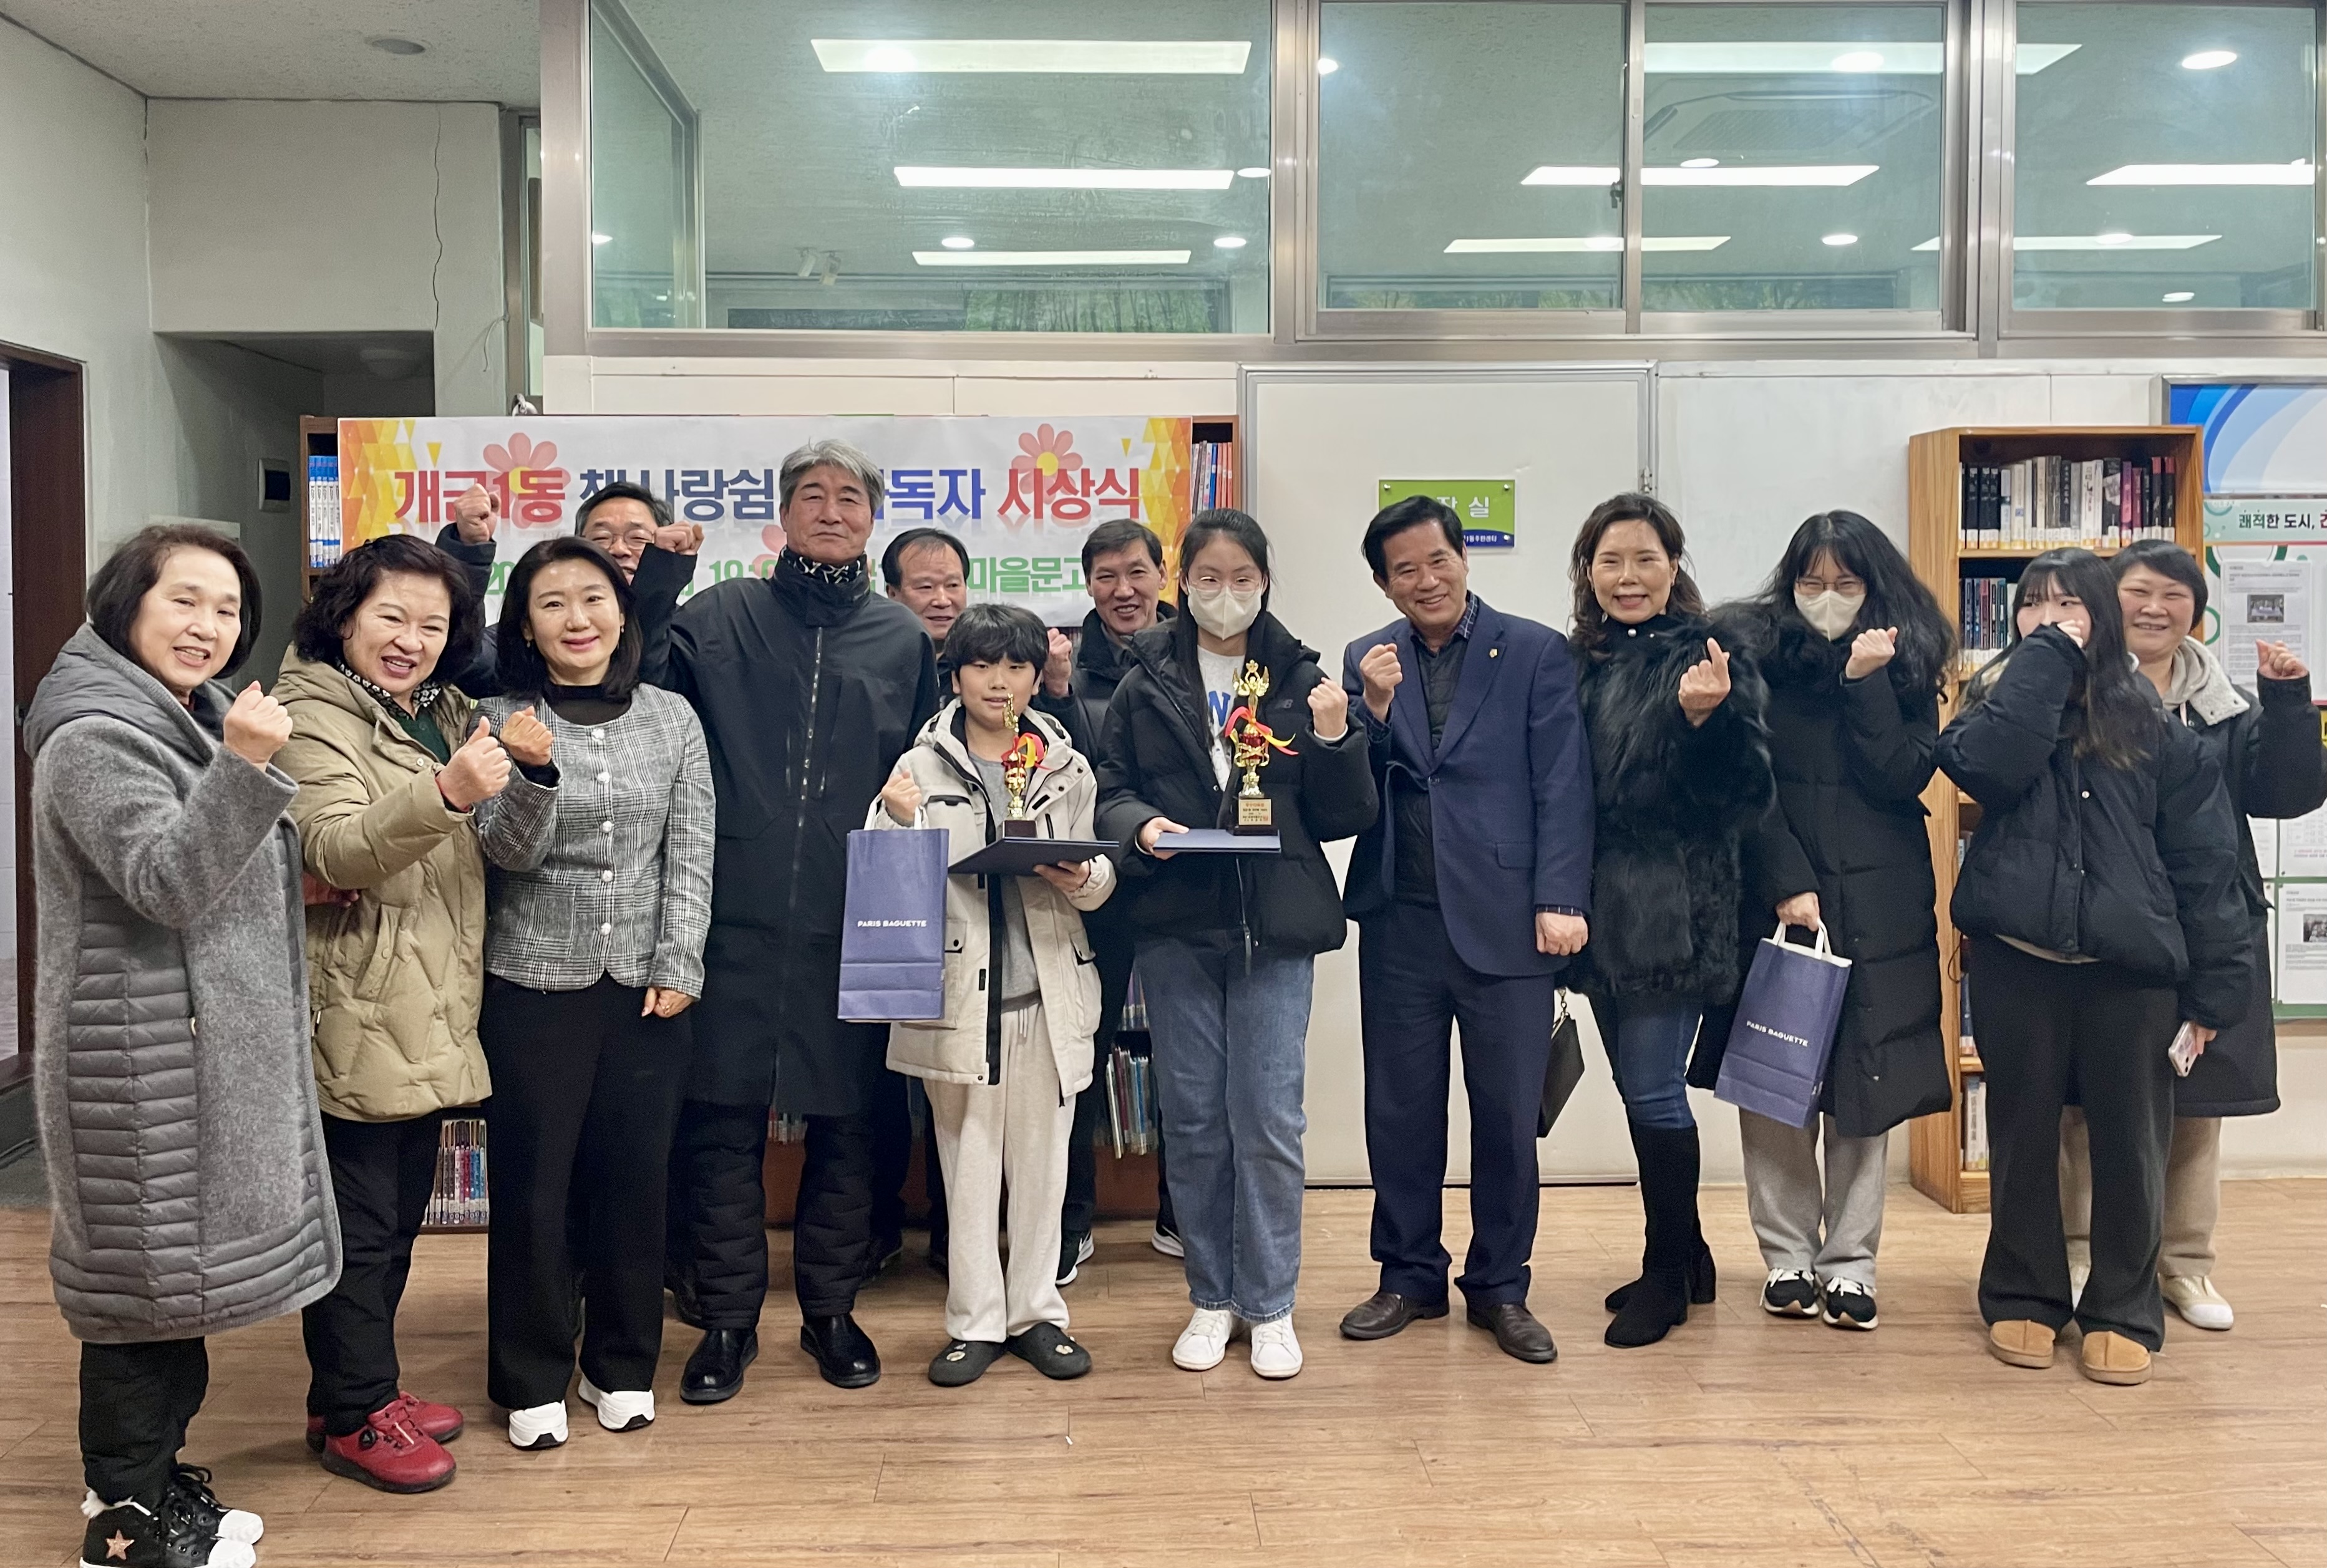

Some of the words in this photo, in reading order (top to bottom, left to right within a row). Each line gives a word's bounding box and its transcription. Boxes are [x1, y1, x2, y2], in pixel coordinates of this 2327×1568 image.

[998, 468, 1140, 520] 시상식
[2284, 513, 2315, 530] 도시,
[1747, 1021, 1767, 1032] PARIS
[1769, 1028, 1808, 1047] BAGUETTE
